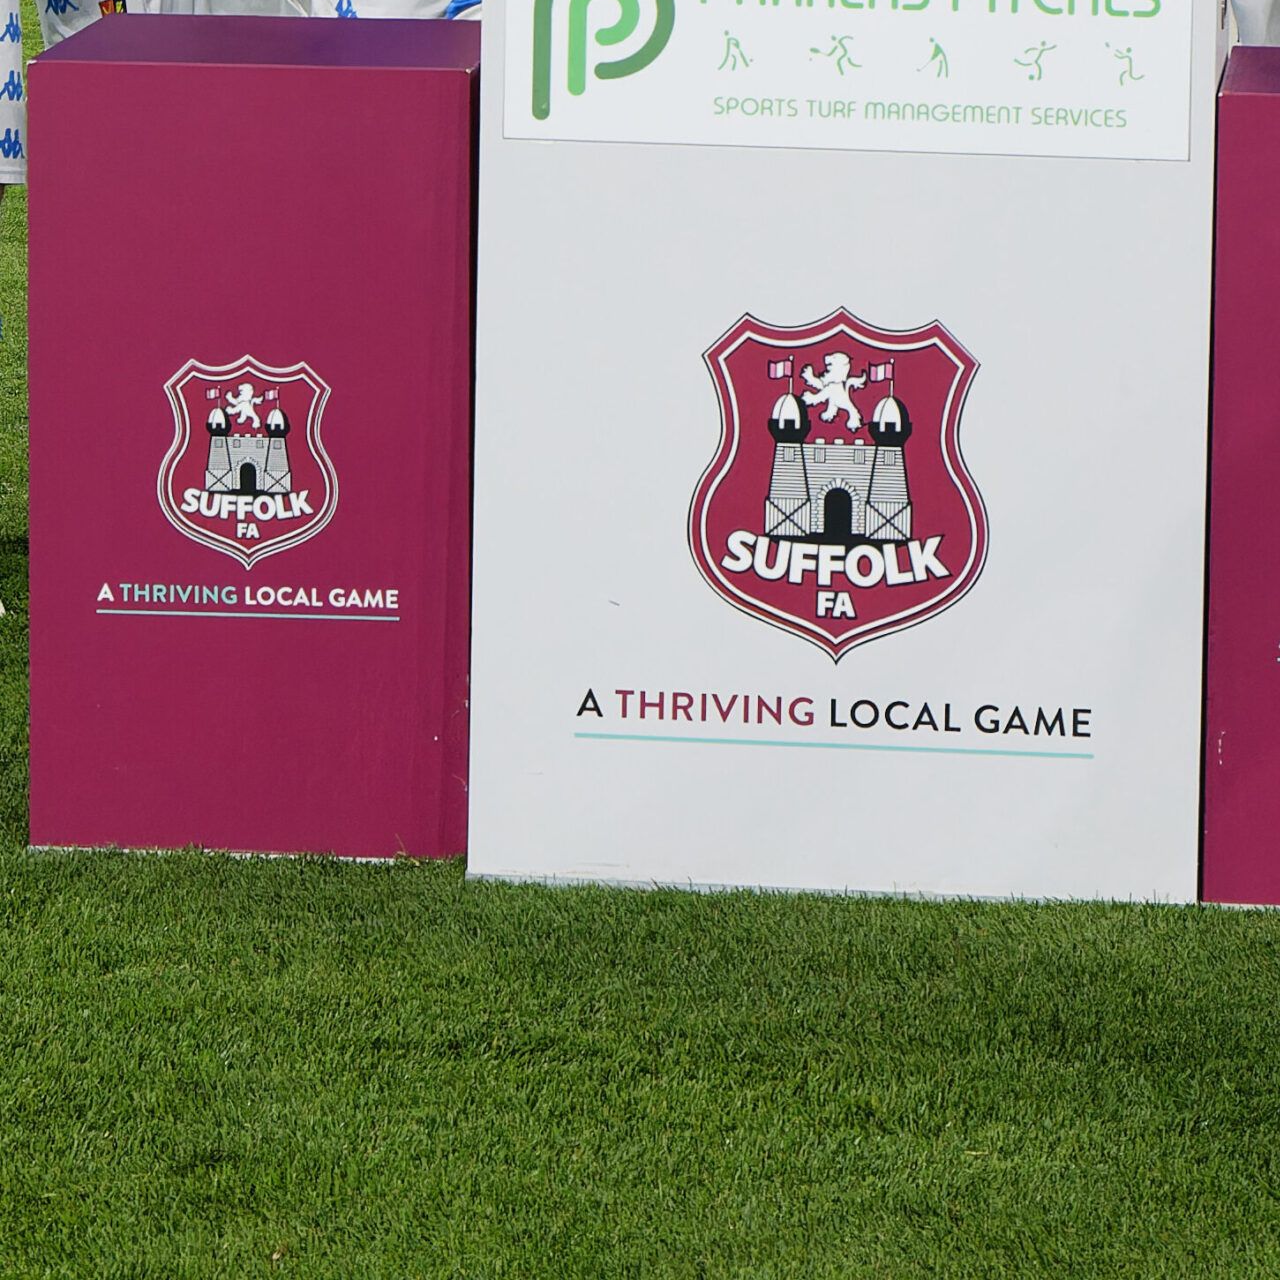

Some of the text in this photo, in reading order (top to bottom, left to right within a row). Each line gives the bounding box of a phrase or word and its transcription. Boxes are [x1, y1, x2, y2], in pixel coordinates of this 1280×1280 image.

[714, 97, 1127, 128] SPORTS TURF MANAGEMENT SERVICES
[181, 488, 313, 520] SUFFOLK
[236, 523, 260, 539] FA
[721, 530, 950, 587] SUFFOLK
[97, 583, 399, 609] A THRIVING LOCAL GAME
[816, 591, 856, 618] FA
[576, 689, 1092, 738] A THRIVING LOCAL GAME
